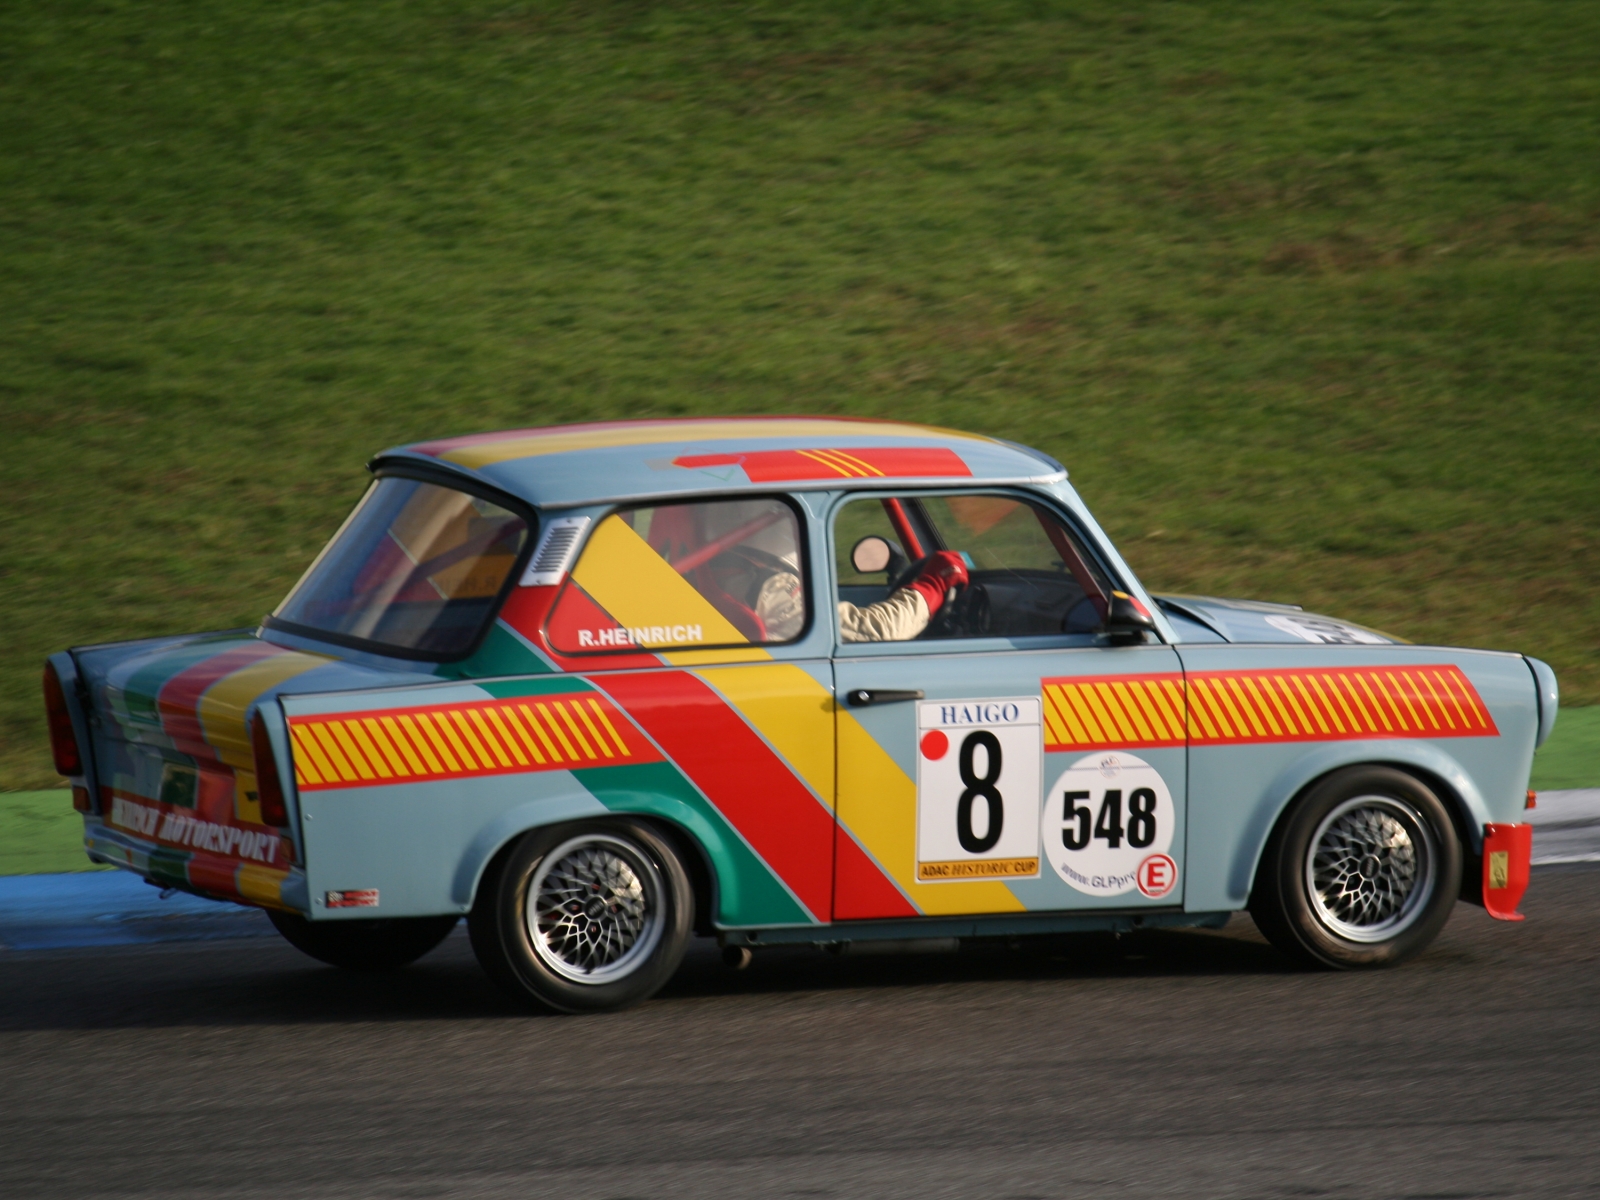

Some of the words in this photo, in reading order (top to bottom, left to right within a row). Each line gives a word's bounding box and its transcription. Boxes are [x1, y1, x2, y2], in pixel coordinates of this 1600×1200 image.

[577, 624, 703, 647] R.HEINRICH
[940, 703, 1019, 725] HAIGO
[957, 729, 1004, 854] 8
[1061, 787, 1157, 851] 548
[158, 812, 281, 864] MOTORSPORT
[921, 864, 950, 877] ADAC
[951, 861, 1013, 876] HISTORIC
[1014, 860, 1036, 873] CUP
[1147, 862, 1167, 887] E
